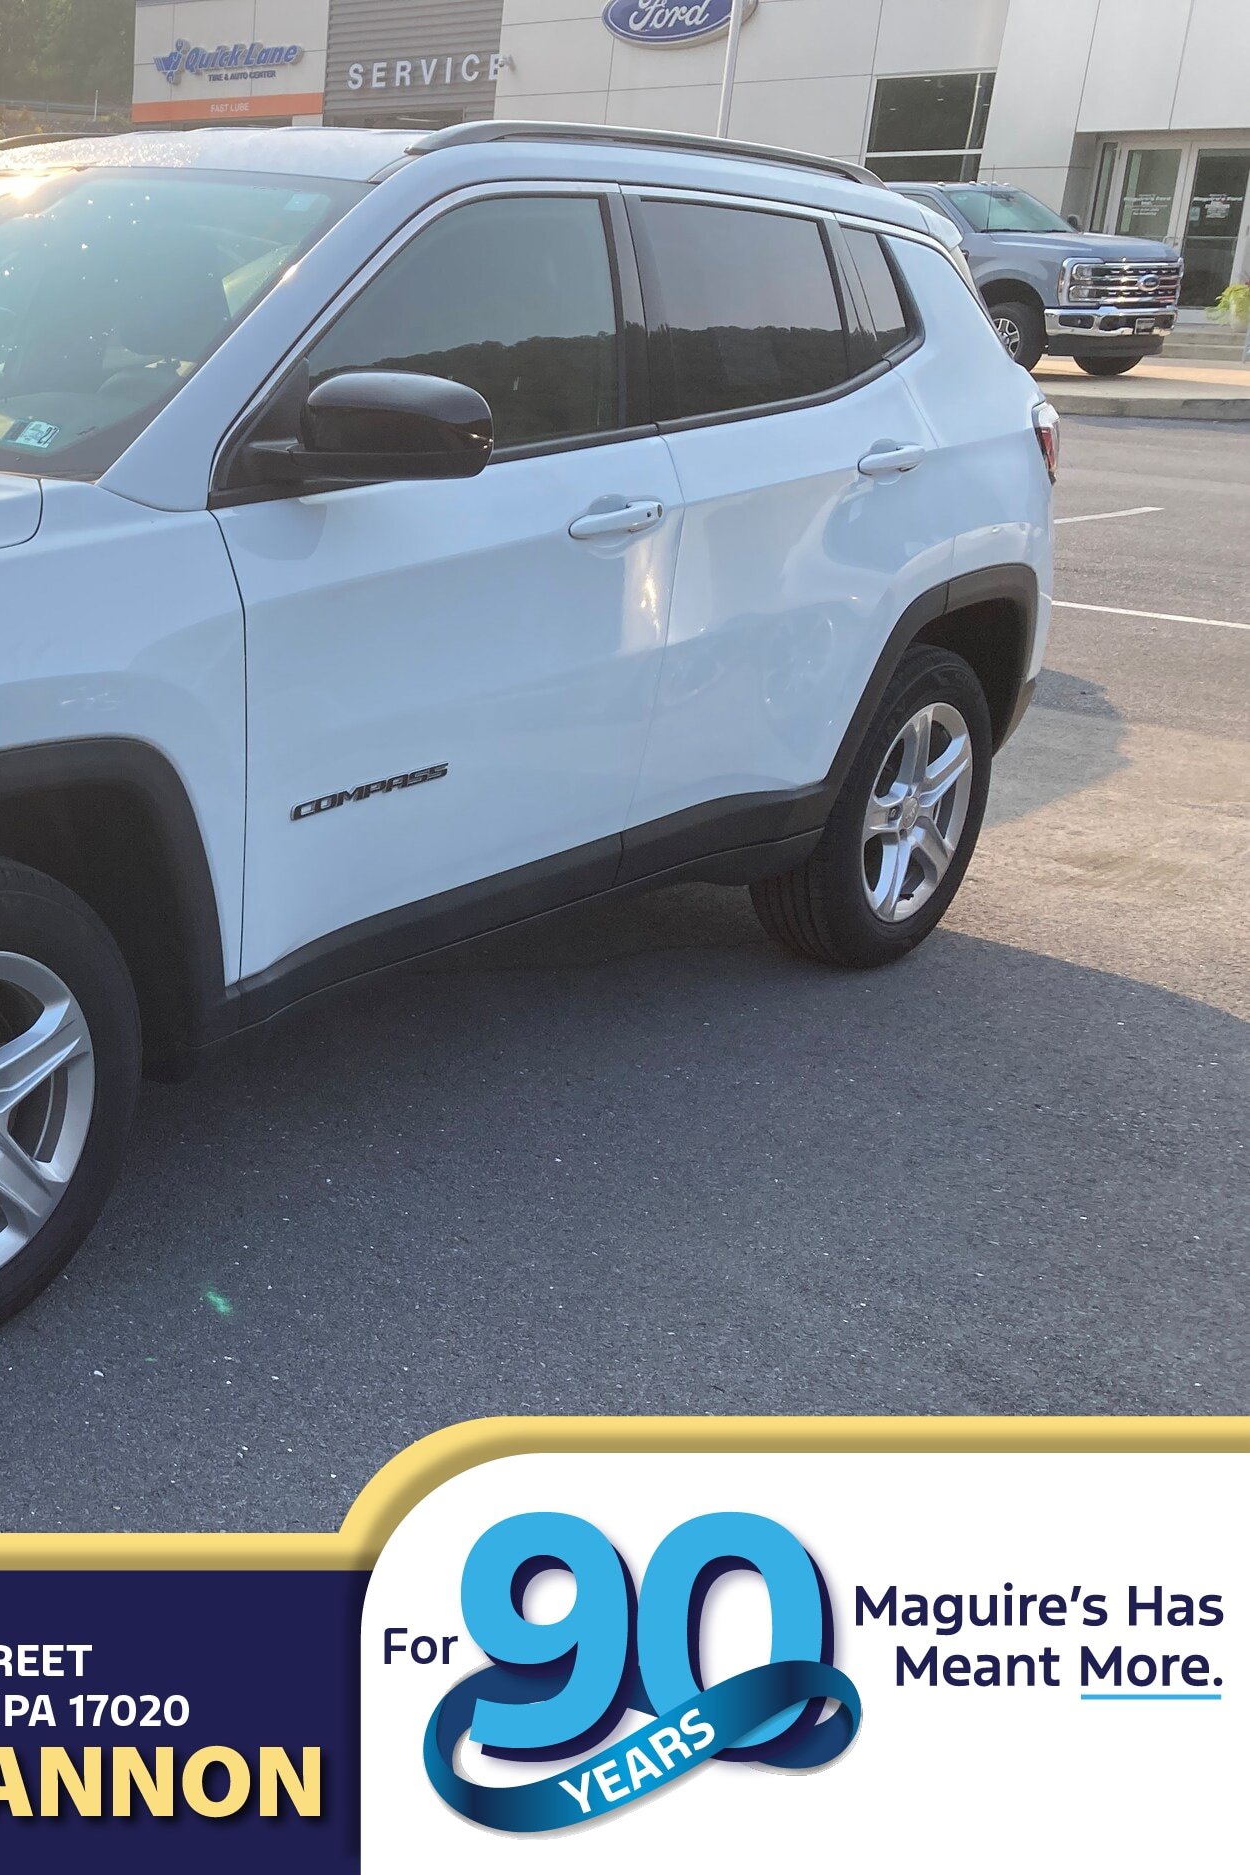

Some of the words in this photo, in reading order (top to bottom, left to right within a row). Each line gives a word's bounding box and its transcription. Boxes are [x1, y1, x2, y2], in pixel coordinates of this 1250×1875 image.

[184, 44, 243, 73] Quick
[243, 42, 299, 66] Lane
[347, 53, 500, 90] SERVICE
[208, 73, 223, 82] TIRE
[230, 72, 248, 81] AUTO
[249, 70, 276, 80] CENTER
[210, 103, 228, 113] FAST
[230, 102, 249, 112] LUBE
[290, 761, 449, 821] COMPASS
